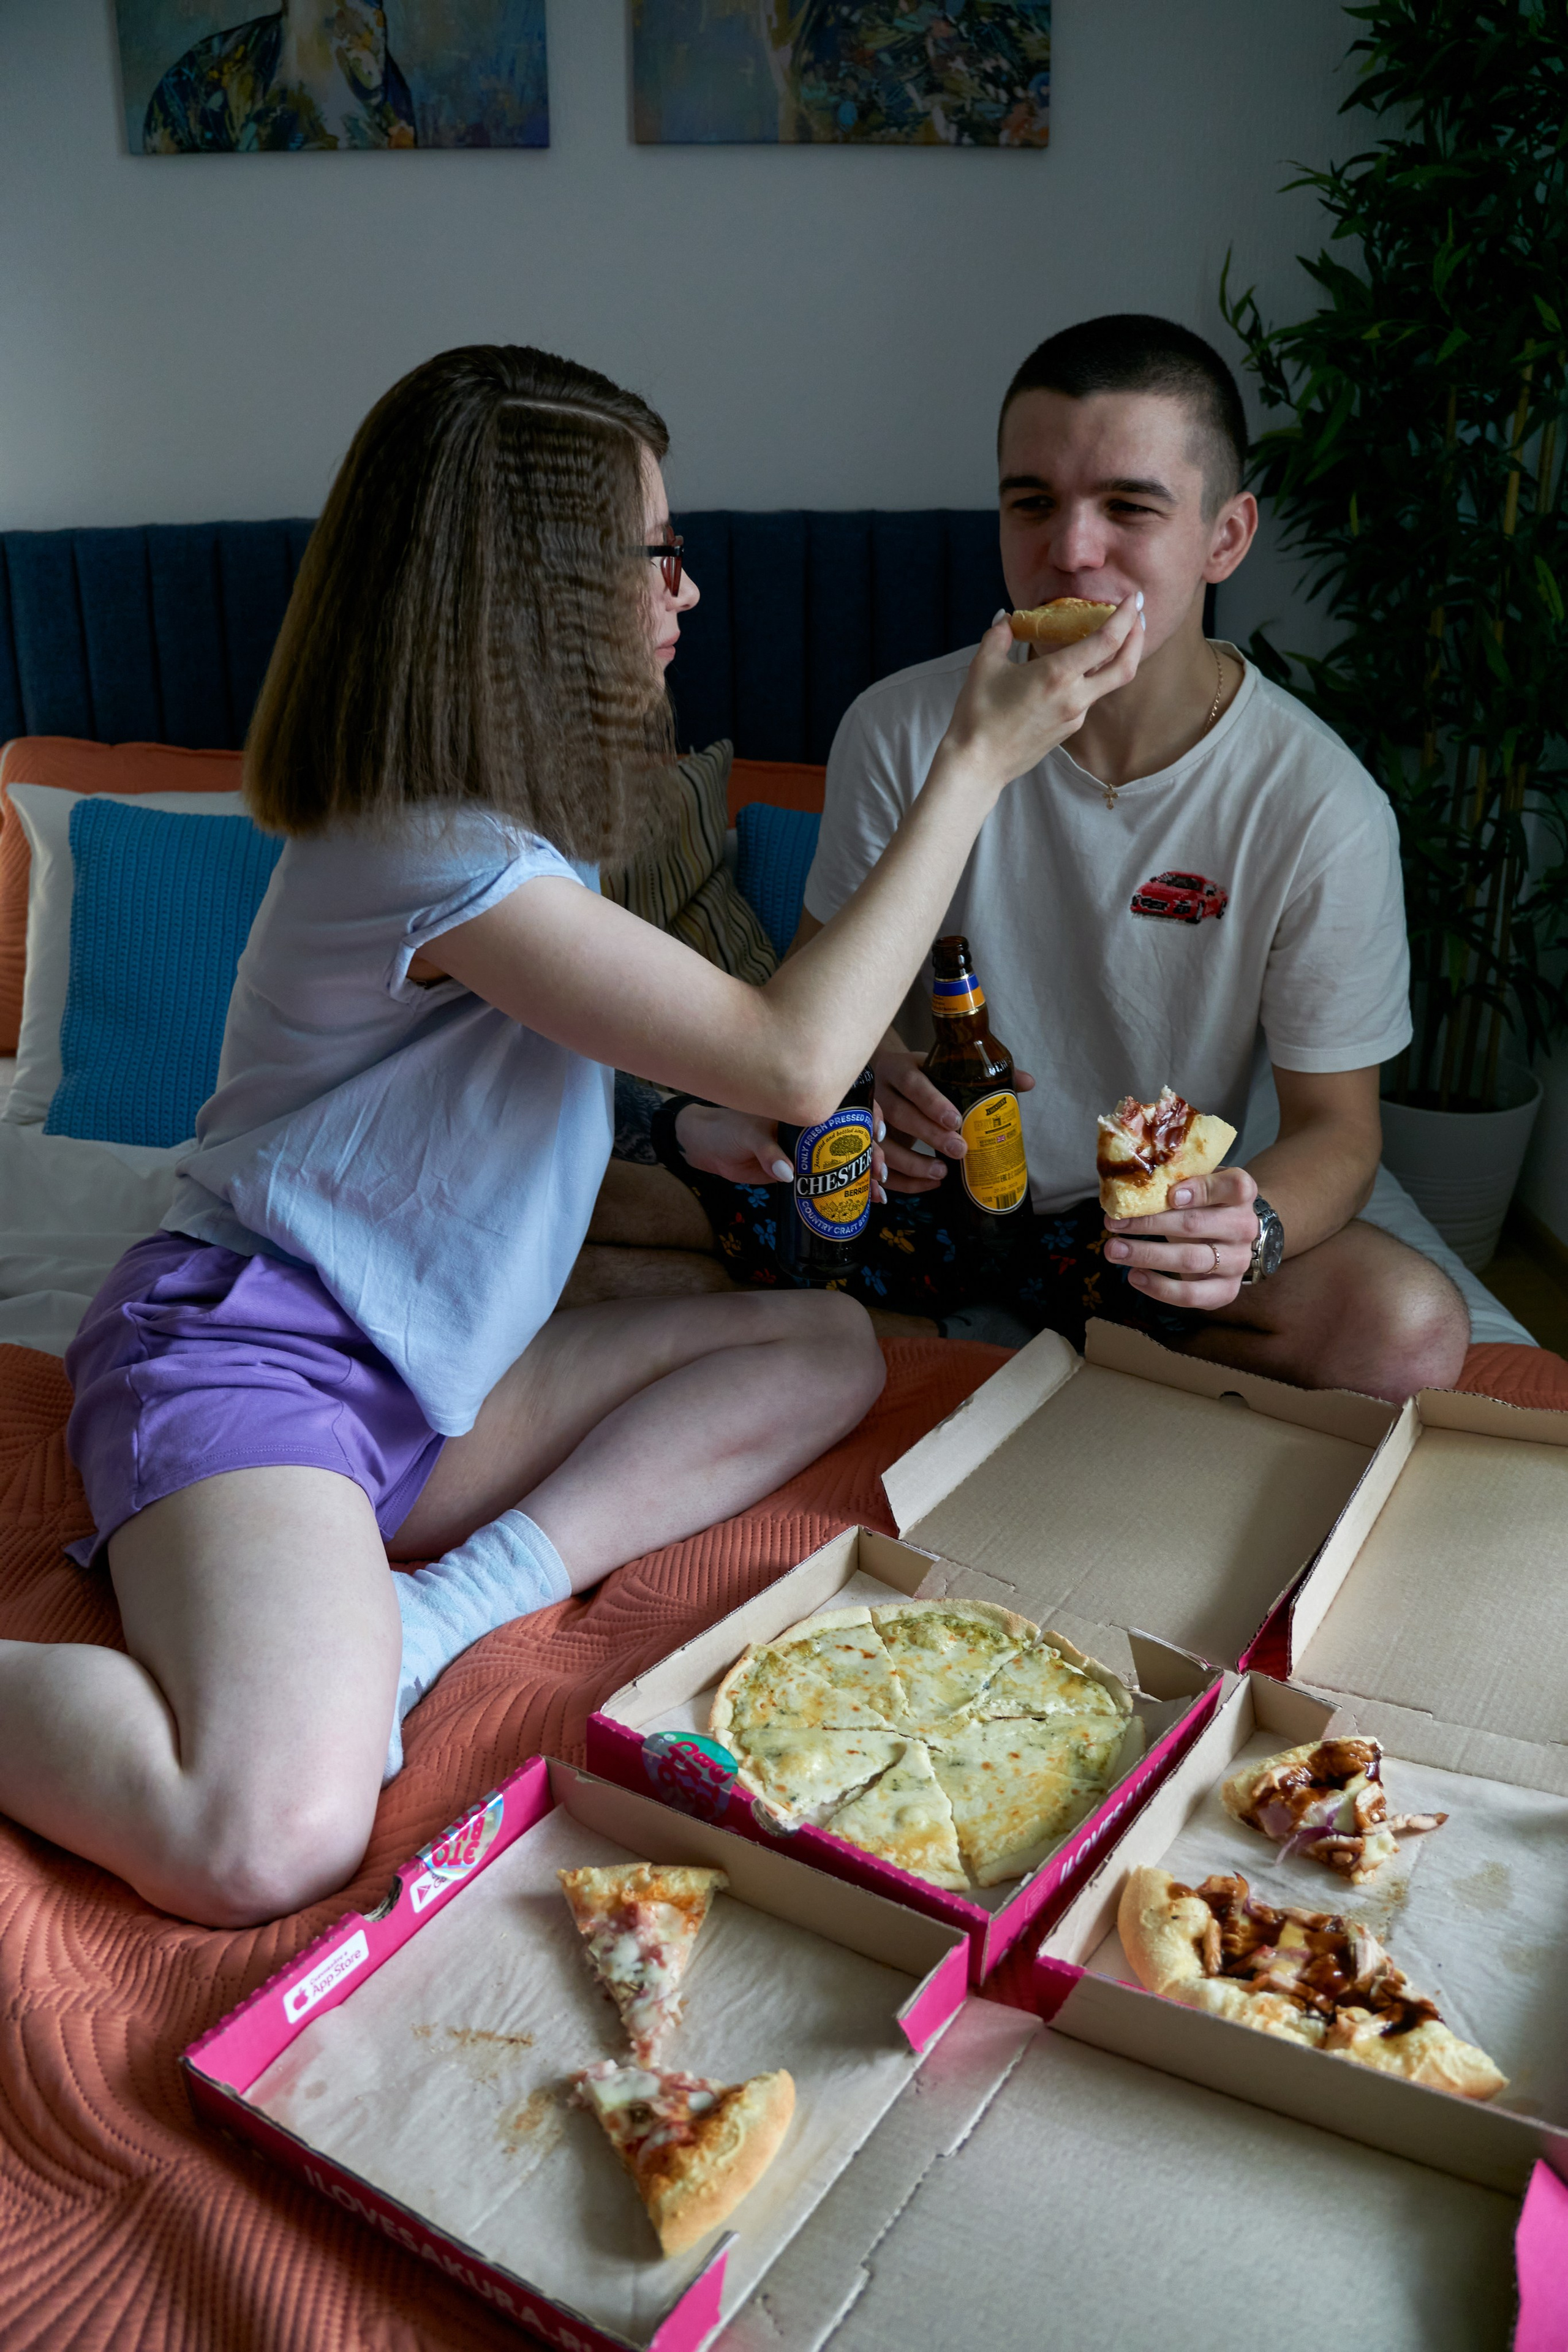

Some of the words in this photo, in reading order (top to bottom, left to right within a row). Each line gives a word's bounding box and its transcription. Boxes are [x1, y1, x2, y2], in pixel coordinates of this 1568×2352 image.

[804, 1122, 828, 1147] FRESH
[828, 1114, 864, 1127] PRESSED
[814, 1140, 826, 1169] Fermented
[826, 1133, 836, 1142] and
[836, 1128, 854, 1136] bottled
[844, 1183, 869, 1197] BERRIES
[802, 1201, 834, 1232] COUNTRY
[834, 1223, 858, 1234] CRAFT
[431, 1841, 480, 1868] ЭТО
[312, 1973, 334, 1997] App
[334, 1950, 361, 1978] Store
